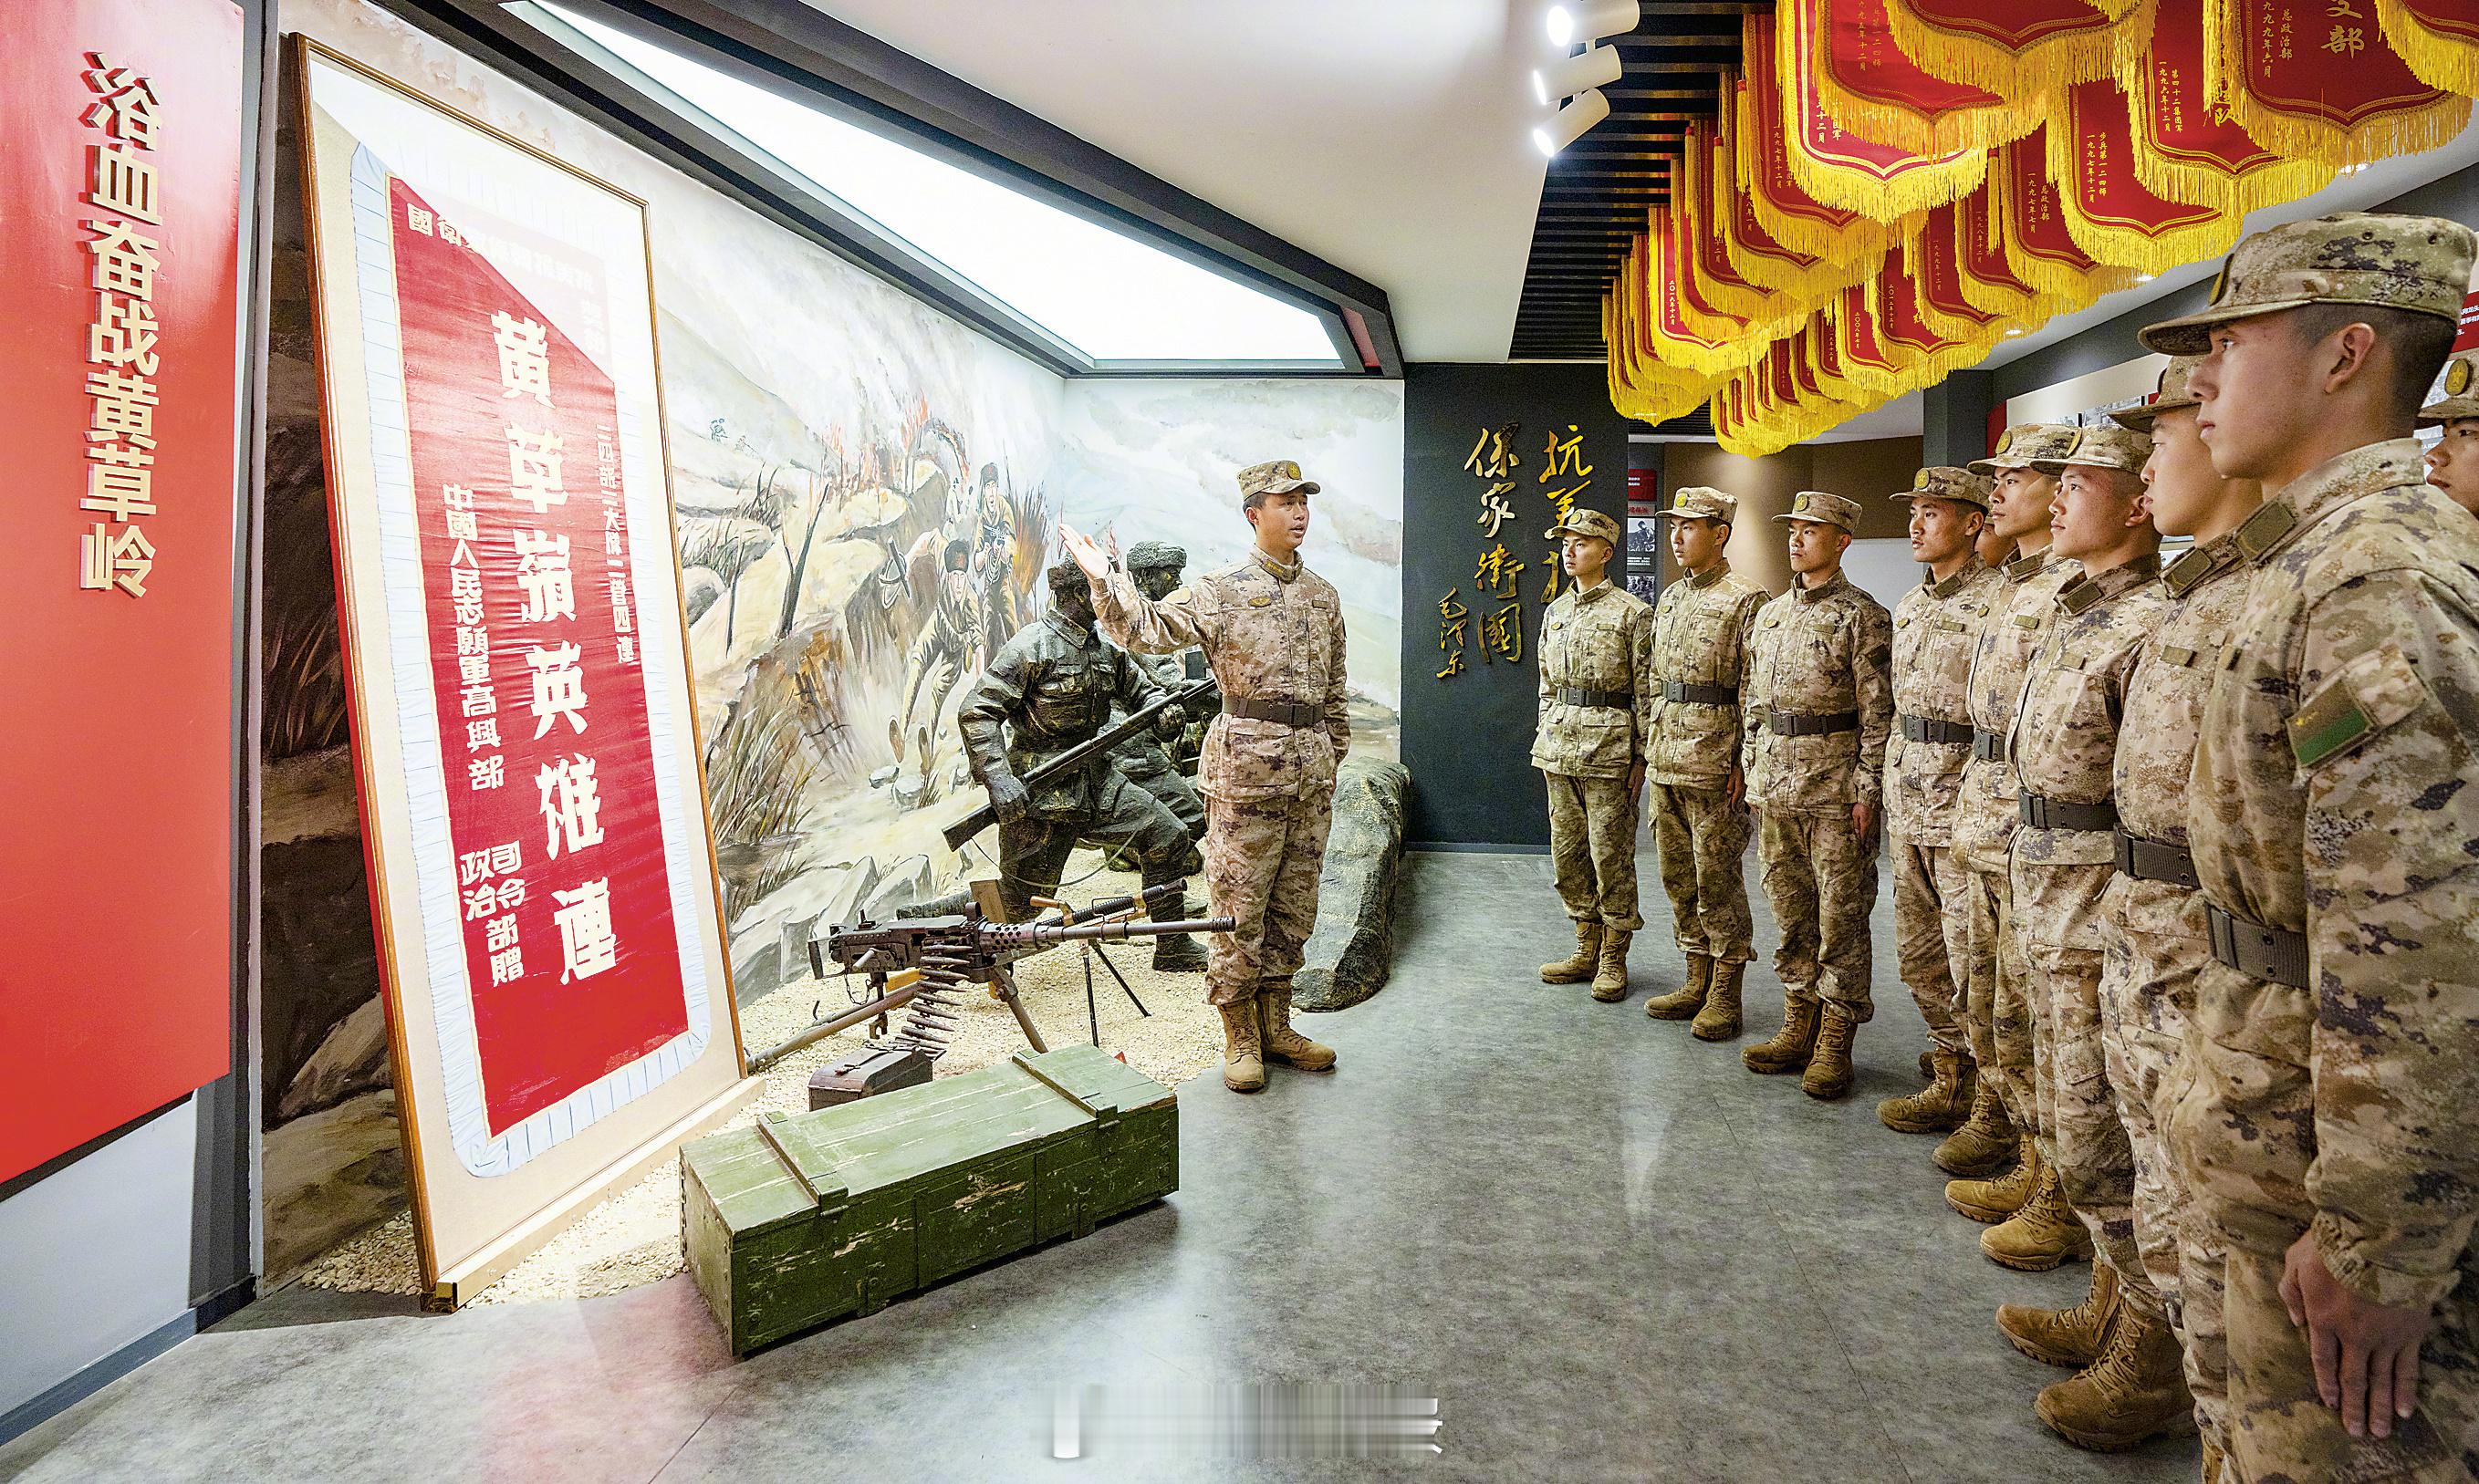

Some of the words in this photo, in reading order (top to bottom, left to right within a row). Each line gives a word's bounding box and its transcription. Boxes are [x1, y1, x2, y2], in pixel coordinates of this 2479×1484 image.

[80, 52, 162, 597] 浴血奋战黄草岭
